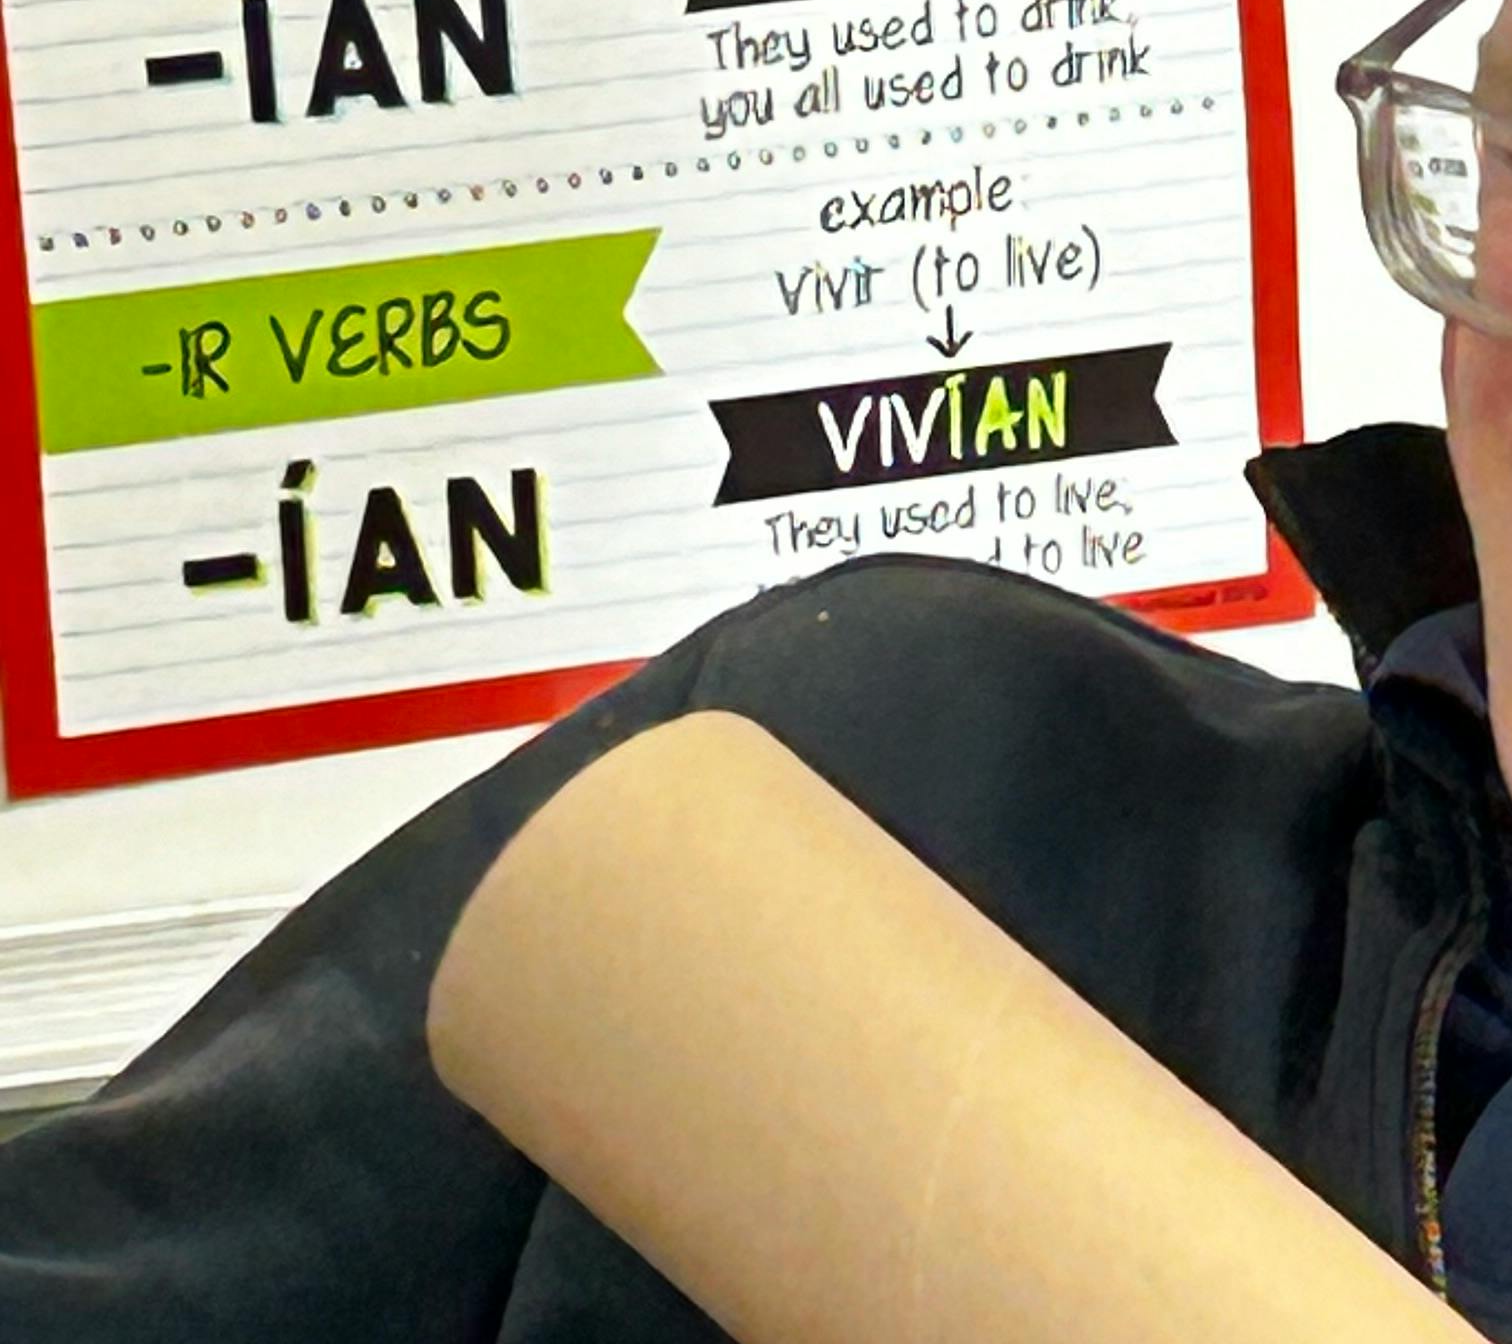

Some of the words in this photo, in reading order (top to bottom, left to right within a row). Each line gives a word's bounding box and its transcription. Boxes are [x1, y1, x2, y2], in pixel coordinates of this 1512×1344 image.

[702, 86, 774, 141] you
[794, 65, 841, 118] all
[863, 53, 963, 111] used
[985, 50, 1029, 94] to
[1051, 32, 1152, 89] drink
[707, 20, 812, 72] They
[912, 243, 980, 313] (to
[1006, 223, 1101, 291] live)
[141, 321, 231, 398] -IR
[270, 290, 512, 384] VERBS
[817, 370, 1069, 473] VIVÍAN
[183, 459, 550, 626] -ÍAN
[765, 510, 861, 556] They
[880, 484, 978, 539] used
[998, 481, 1036, 523] to
[1022, 532, 1063, 575] to
[1081, 523, 1148, 570] live
